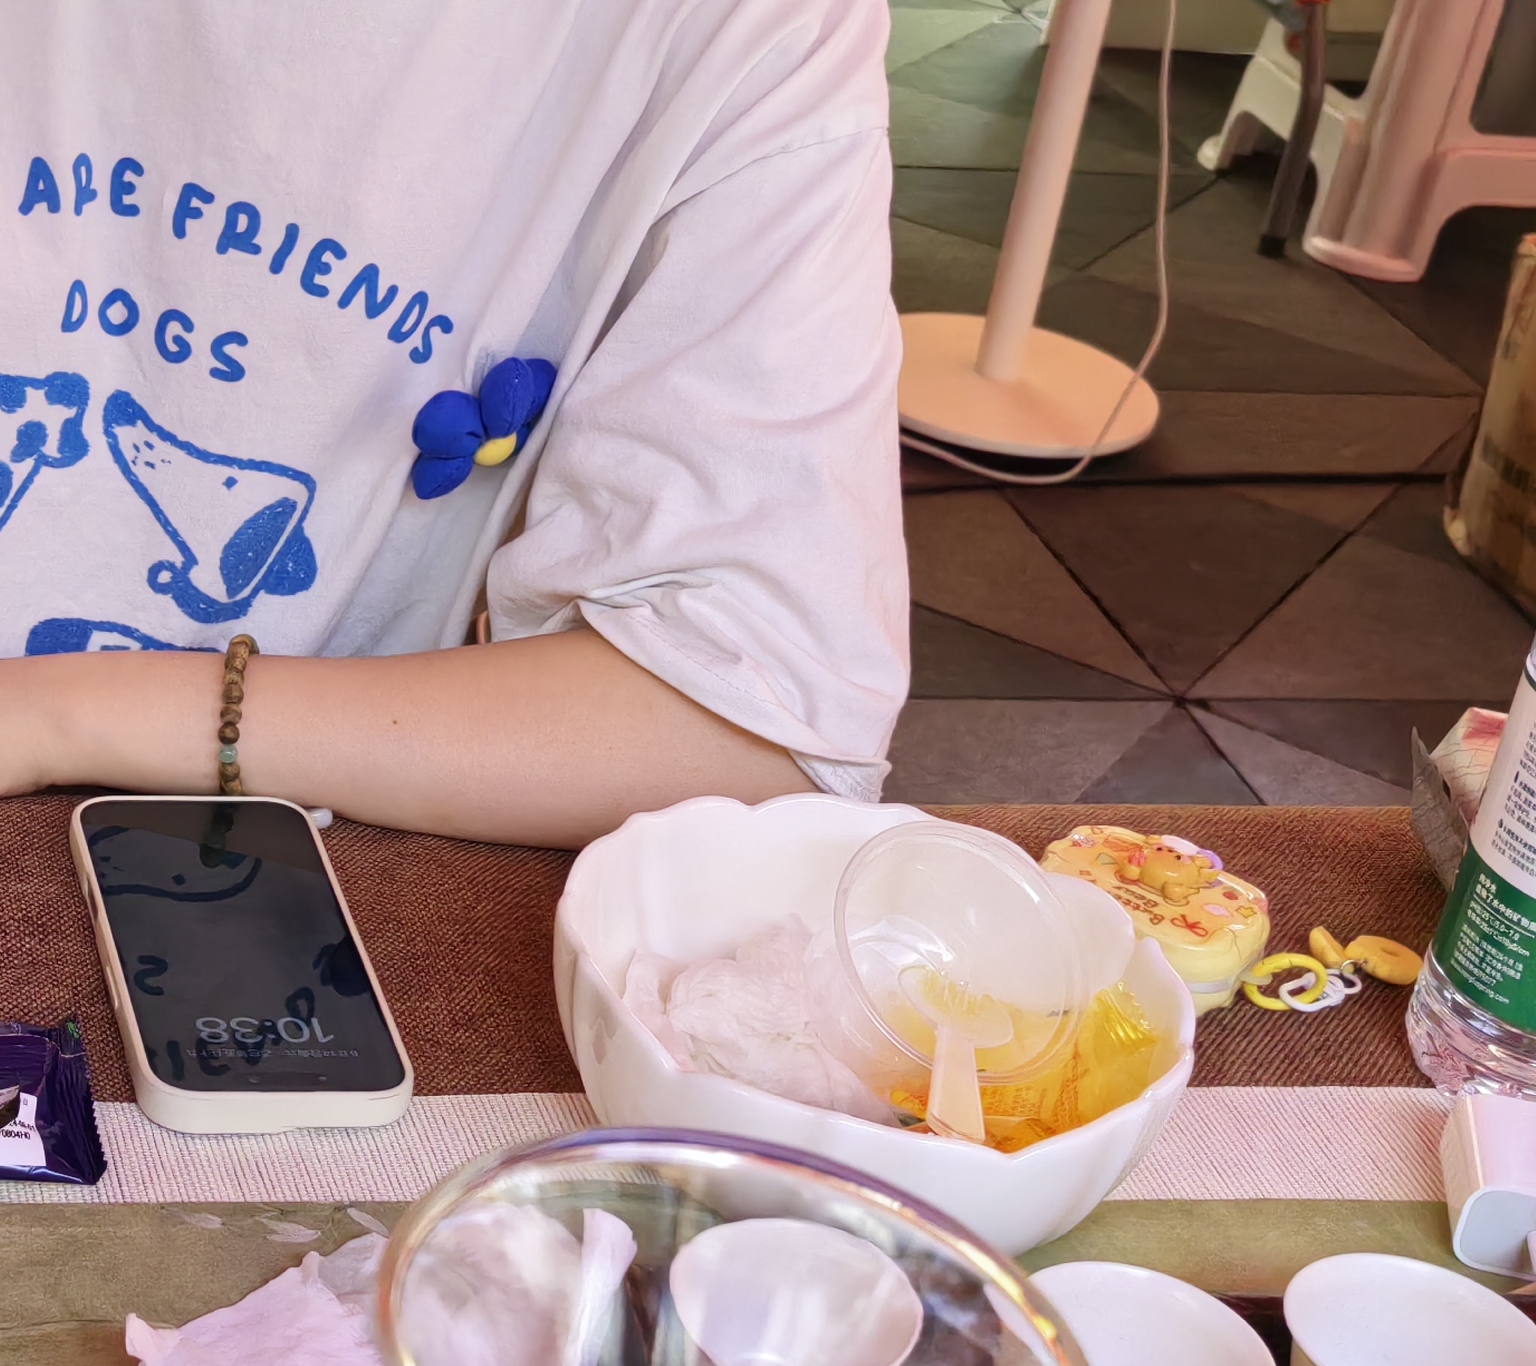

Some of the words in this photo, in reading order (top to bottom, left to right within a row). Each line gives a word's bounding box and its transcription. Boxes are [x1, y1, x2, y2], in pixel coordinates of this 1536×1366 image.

[172, 181, 455, 365] FRIENDS
[61, 280, 251, 383] DOGS
[194, 1016, 335, 1045] 10:38
